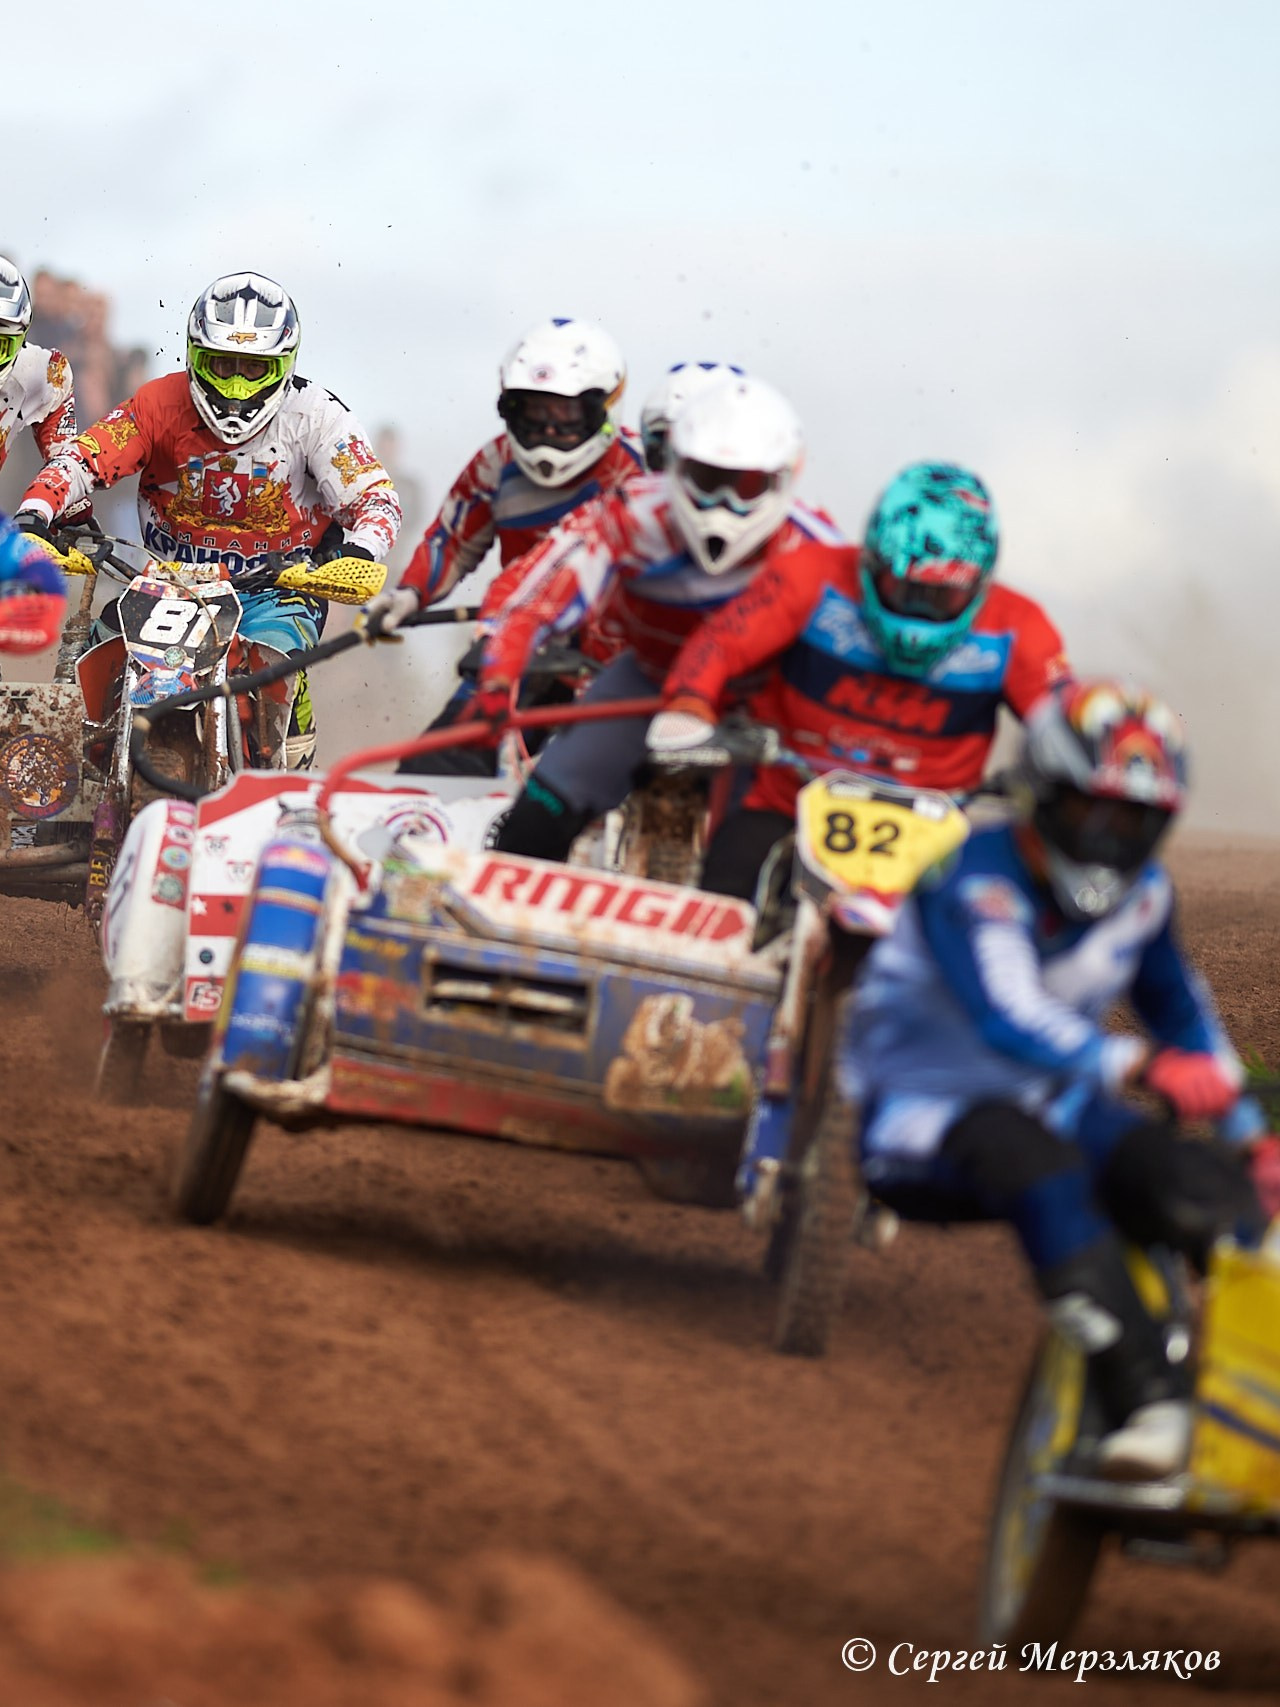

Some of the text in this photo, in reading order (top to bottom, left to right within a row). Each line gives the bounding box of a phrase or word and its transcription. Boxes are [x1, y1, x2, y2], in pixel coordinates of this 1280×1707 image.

[150, 510, 312, 549] КОМПАНИЯ
[139, 600, 221, 647] 81
[824, 812, 900, 857] 82
